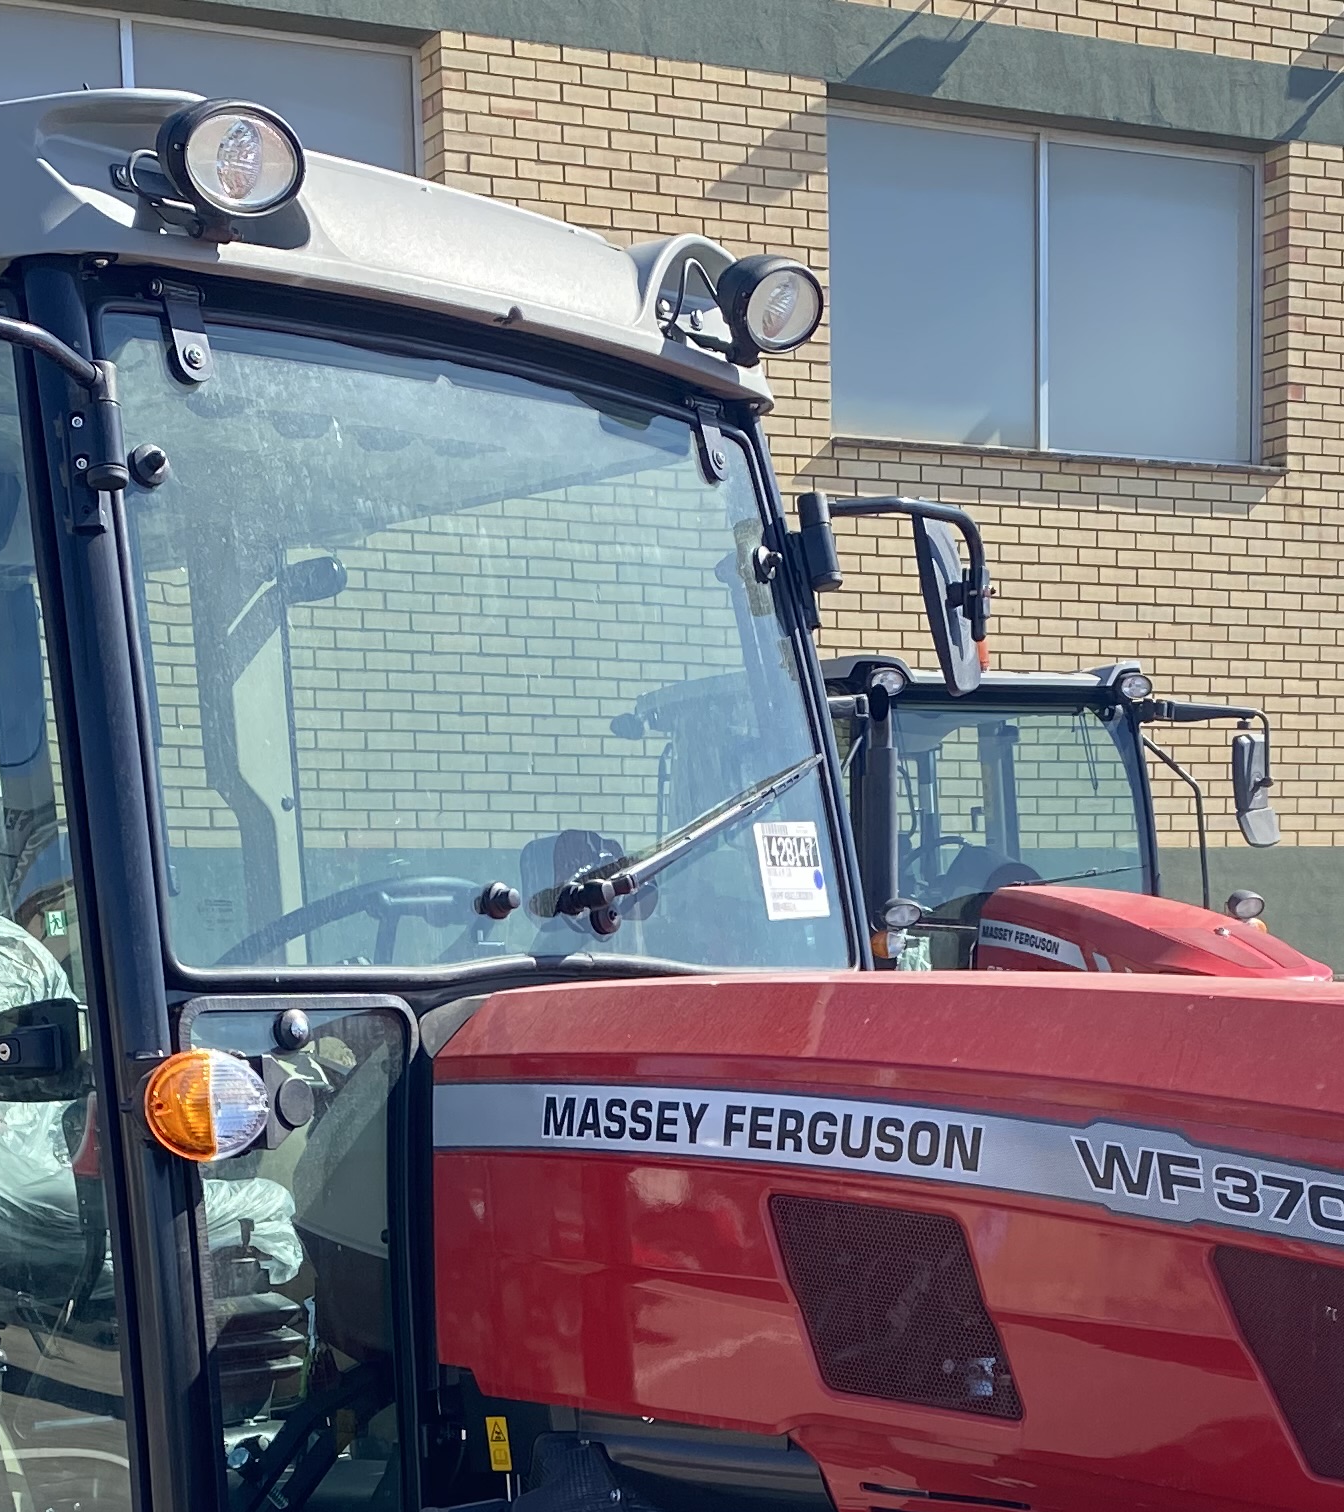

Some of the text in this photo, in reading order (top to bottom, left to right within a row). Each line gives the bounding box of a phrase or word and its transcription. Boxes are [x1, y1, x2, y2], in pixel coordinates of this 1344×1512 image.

[763, 836, 817, 867] 1428147
[981, 925, 1060, 955] MASSEY FERGUSON
[543, 1095, 984, 1173] MASSEY FERGUSON
